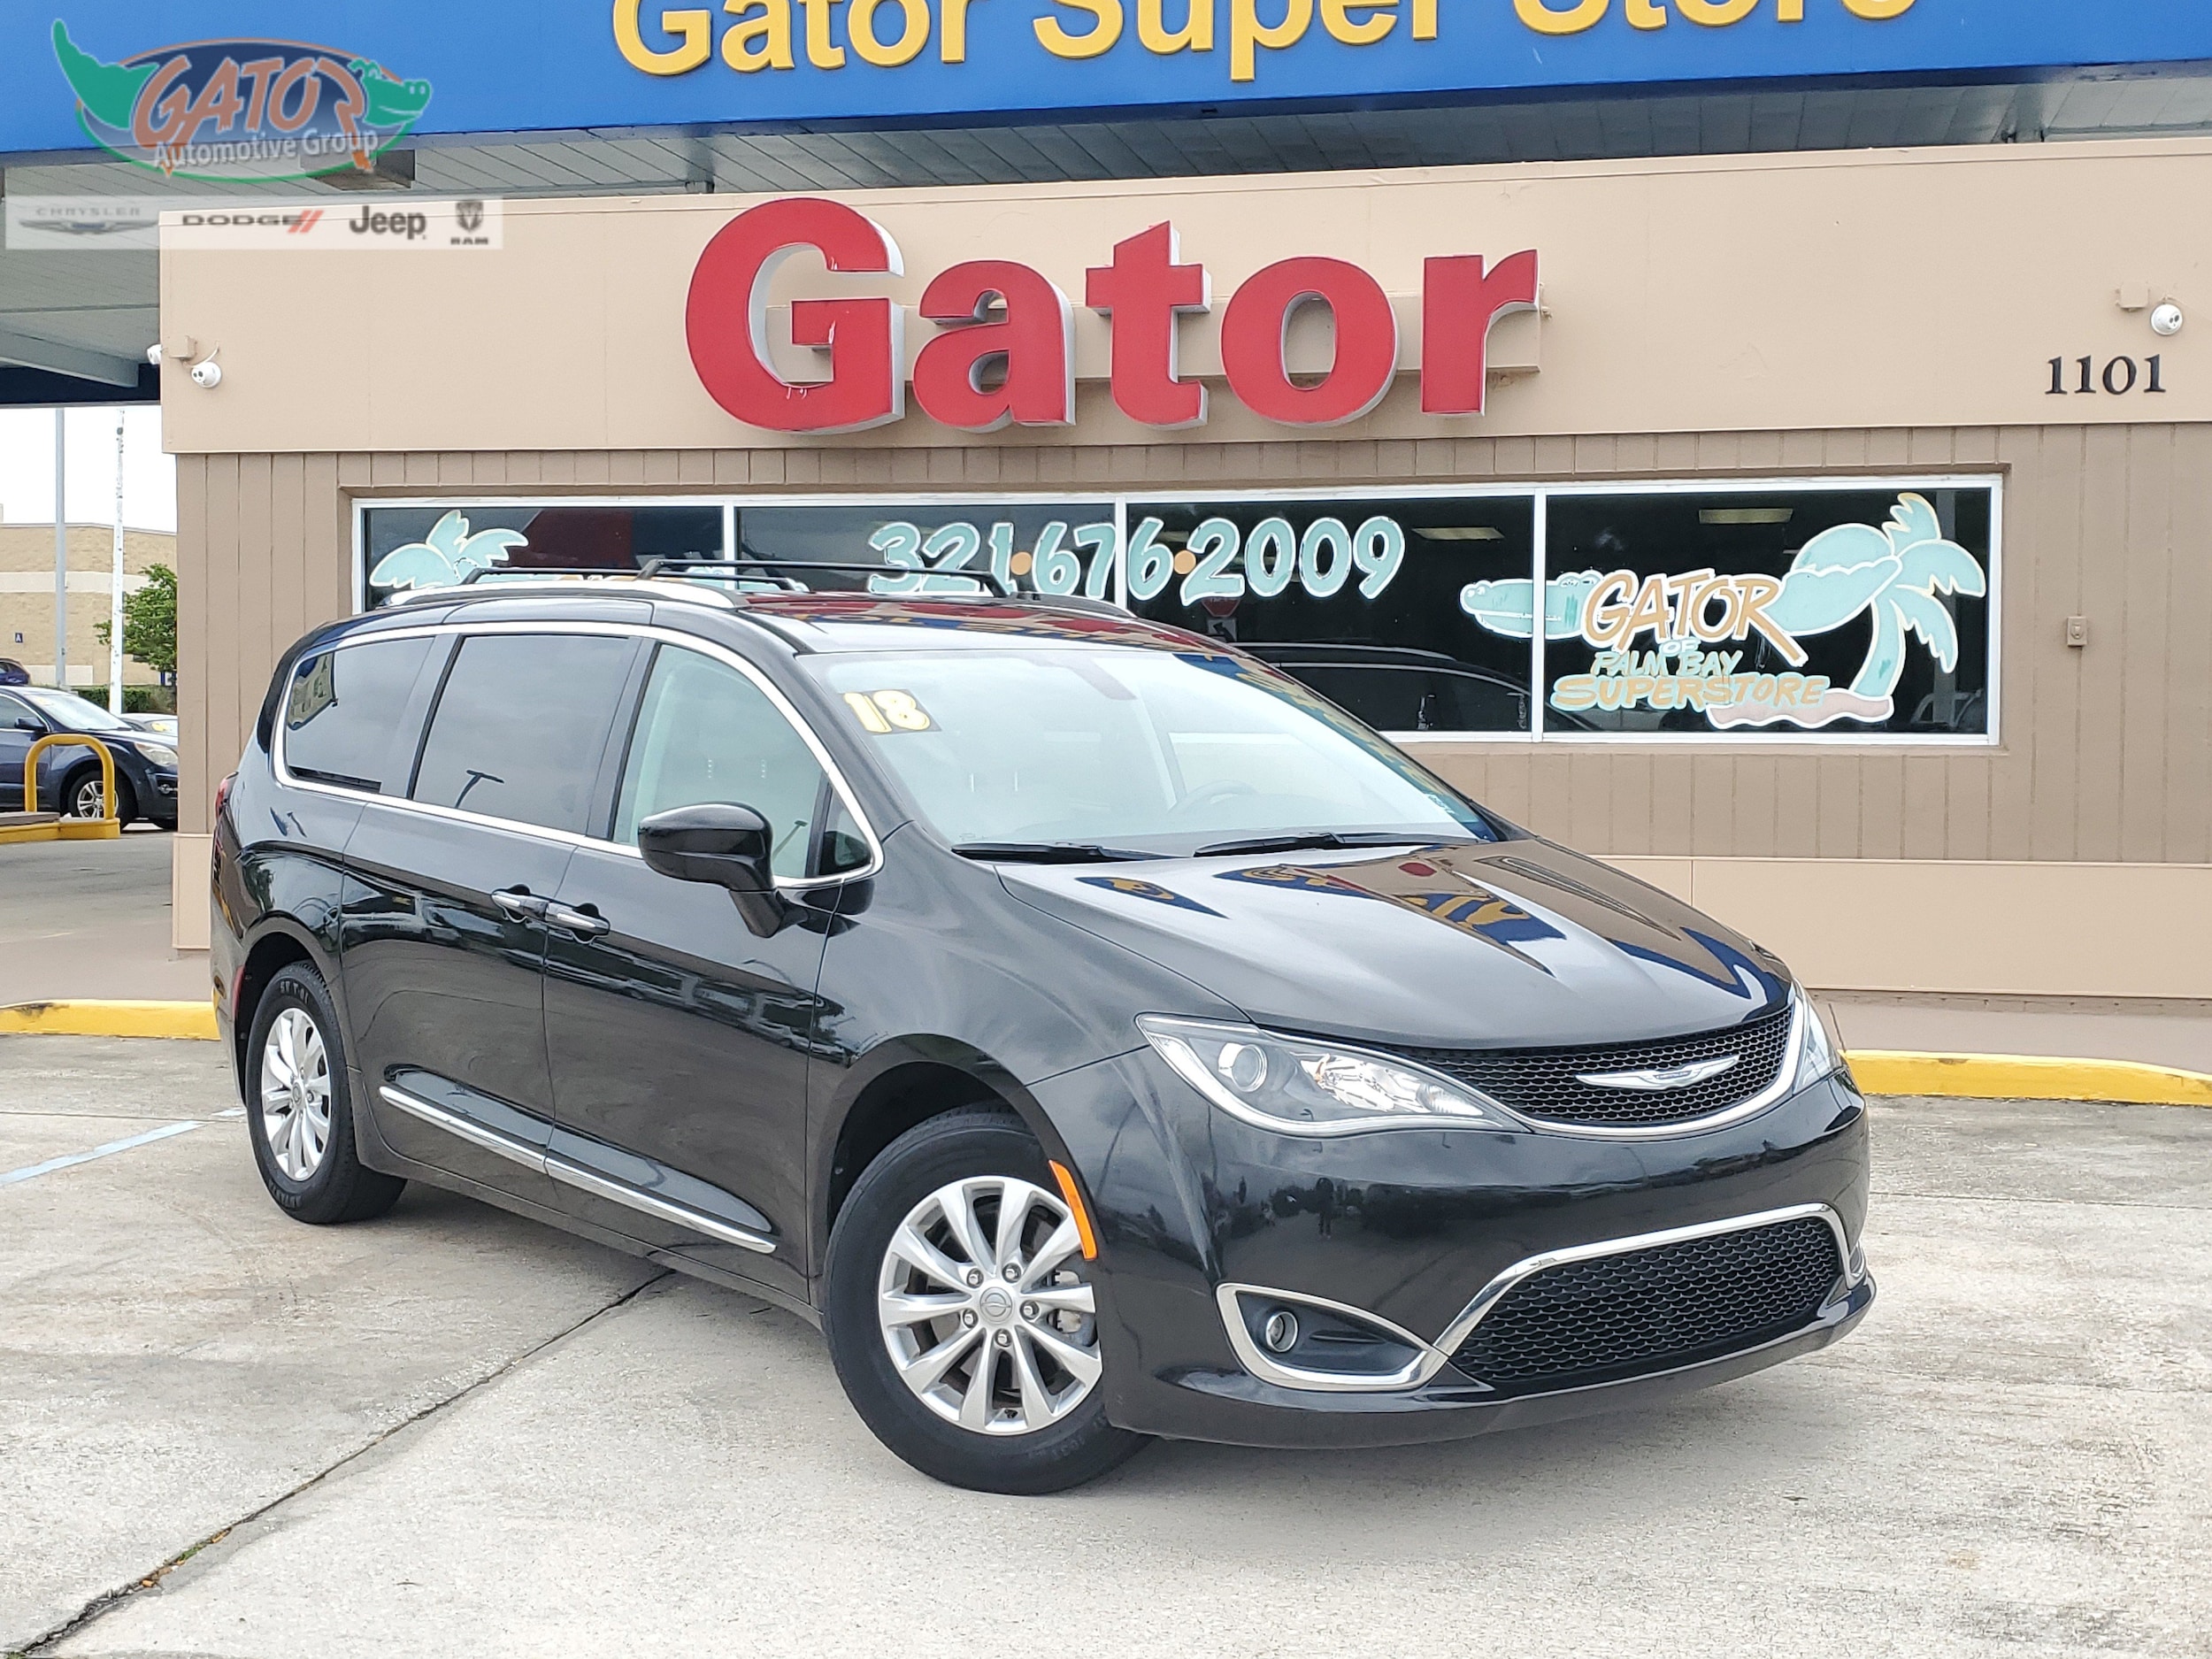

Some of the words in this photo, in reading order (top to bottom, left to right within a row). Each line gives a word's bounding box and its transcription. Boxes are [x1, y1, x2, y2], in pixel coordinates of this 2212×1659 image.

[613, 0, 971, 76] Gator
[686, 197, 1541, 434] Gator
[2045, 354, 2166, 395] 1101
[1585, 569, 1808, 665] GATOR
[1591, 649, 1668, 678] PALM
[1677, 649, 1743, 678] BAY
[1660, 636, 1701, 657] OF
[843, 689, 931, 733] 18
[1551, 673, 1829, 711] SUPERSTORE
